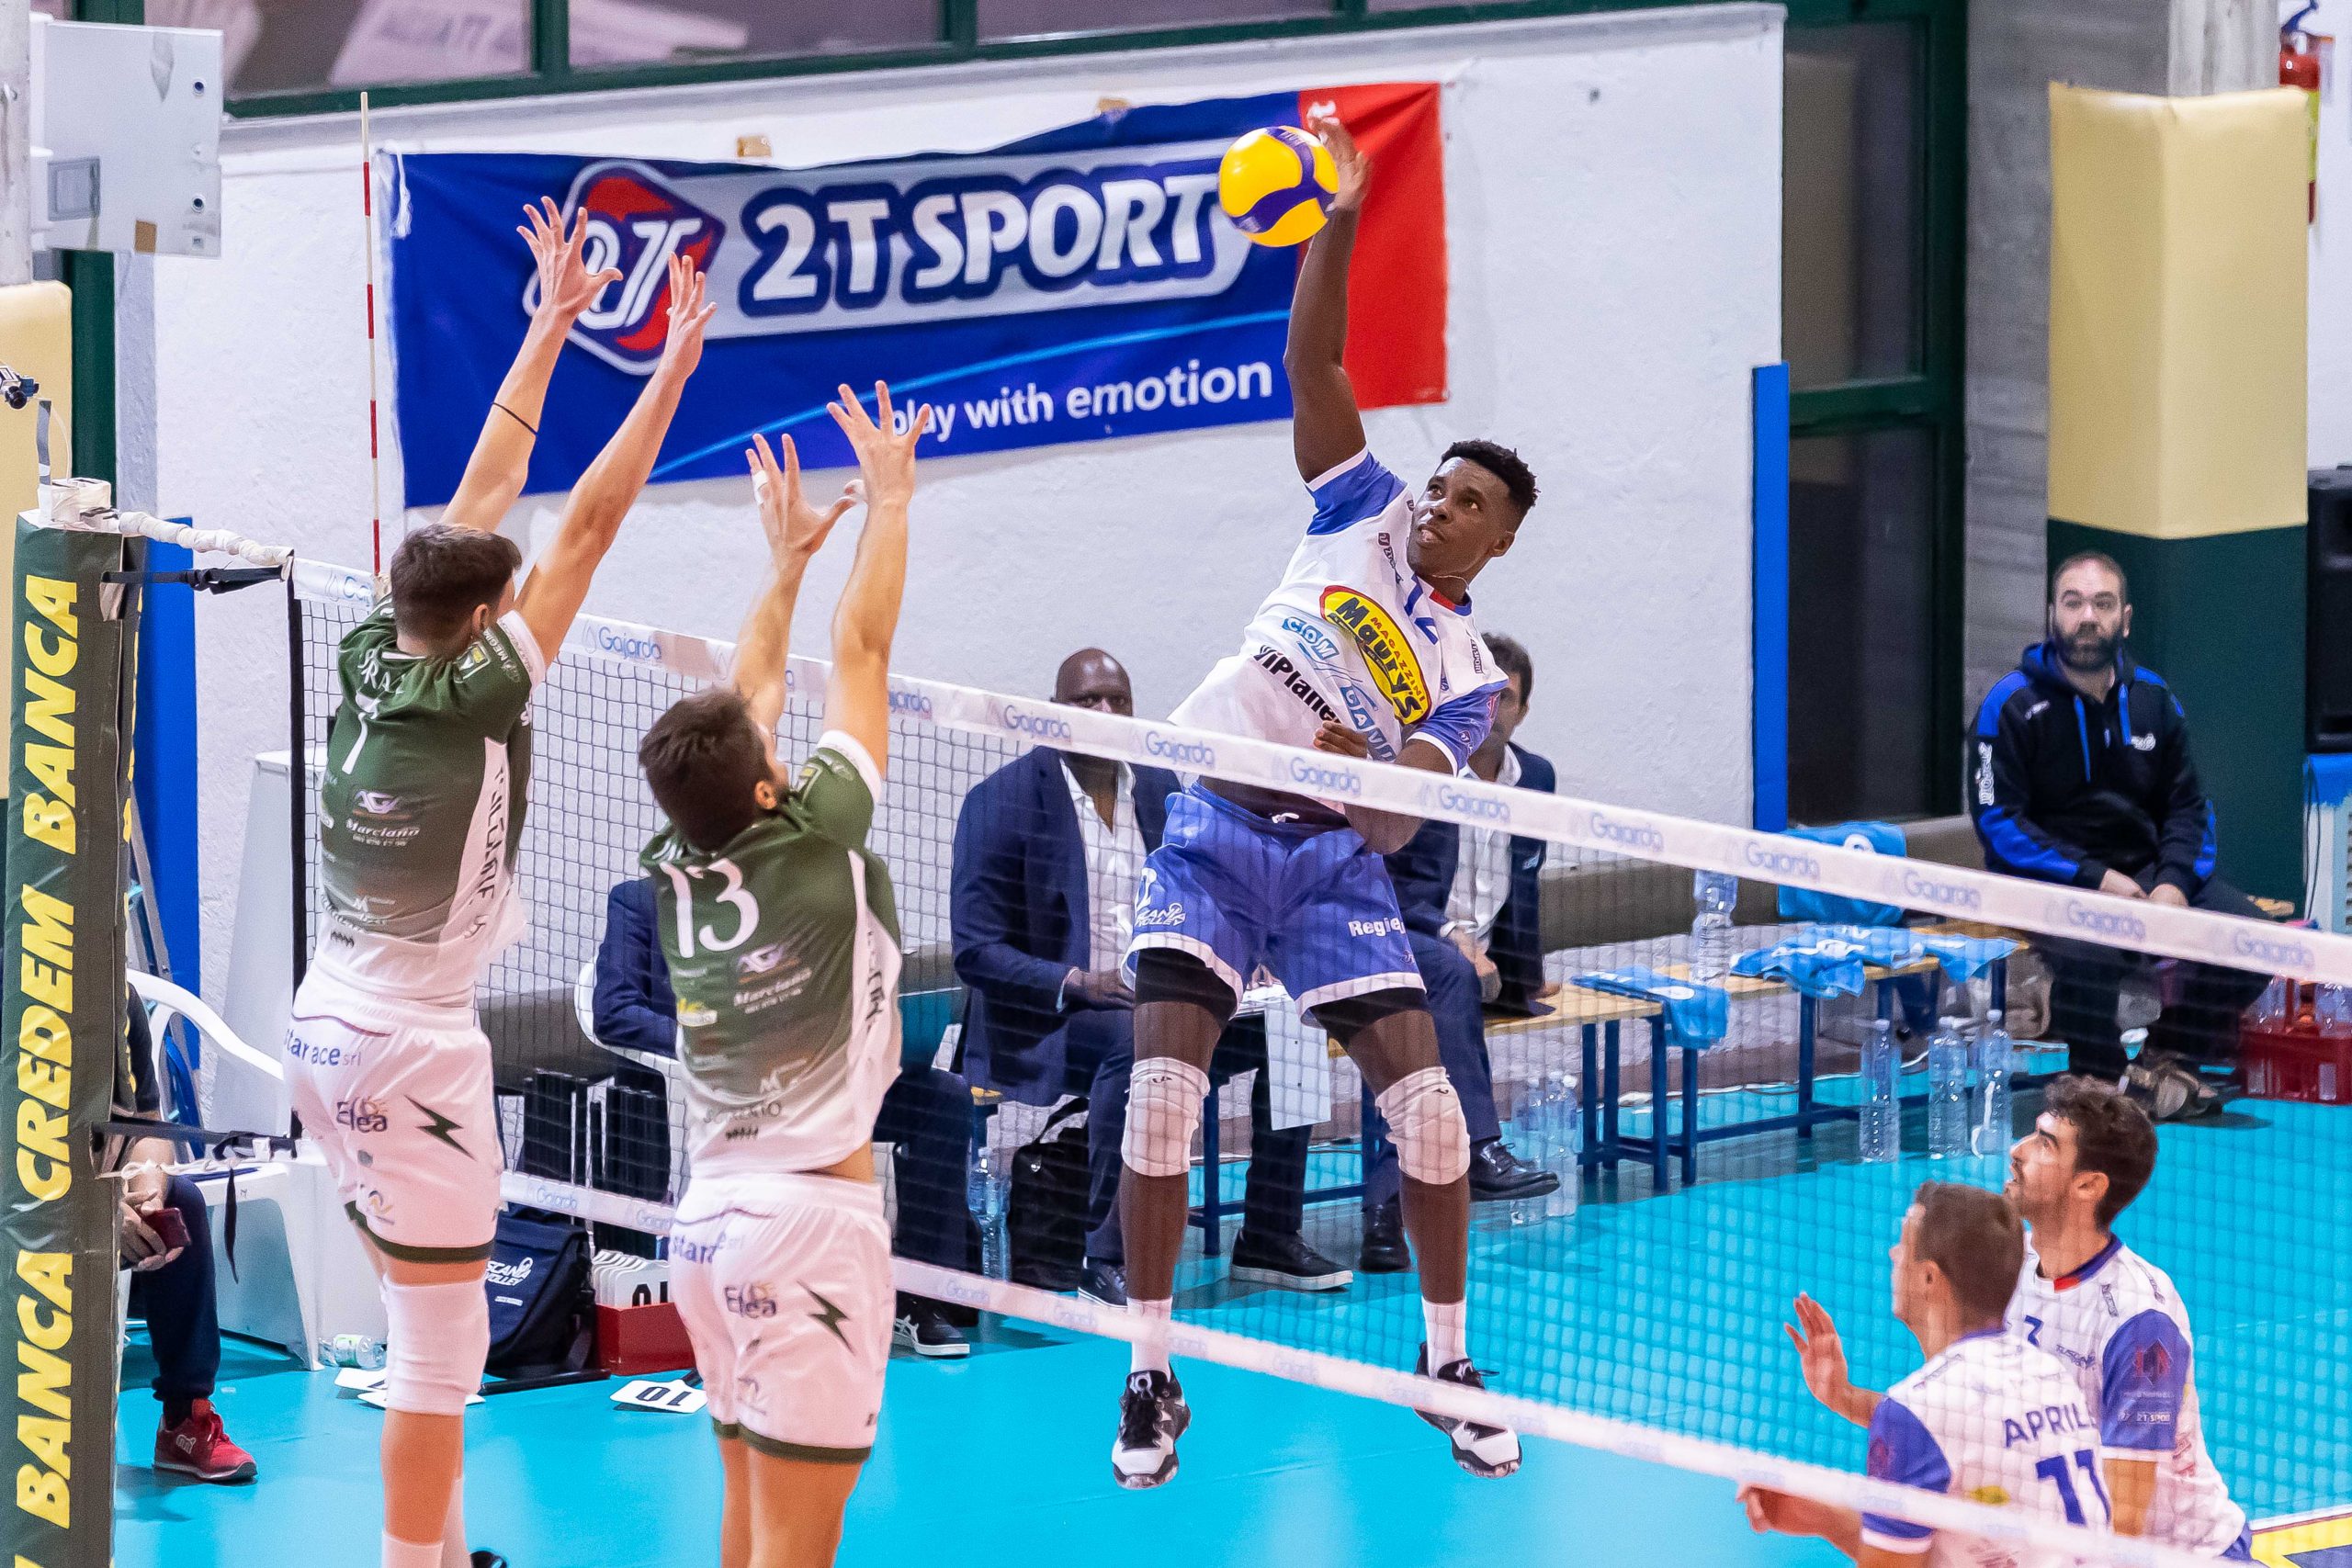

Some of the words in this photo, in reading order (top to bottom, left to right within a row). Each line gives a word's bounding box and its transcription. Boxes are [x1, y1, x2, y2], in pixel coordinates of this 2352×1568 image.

[911, 174, 1218, 288] SPORT
[964, 382, 1054, 430] with
[1066, 359, 1273, 419] emotion
[598, 626, 662, 660] Gajarda
[1281, 616, 1340, 660] COM
[1335, 597, 1423, 718] Maury's
[1370, 616, 1426, 702] MAGAZZINI
[23, 574, 79, 855] BANCA
[1003, 705, 1072, 739] Gajarda
[1146, 729, 1216, 766] Gajarda
[1290, 756, 1362, 793] Gajarda
[659, 857, 760, 958] 13
[16, 883, 75, 1201] CREDEM
[336, 1100, 388, 1134] Elea
[16, 1248, 74, 1529] BANCA
[2003, 1403, 2098, 1449] APRIL
